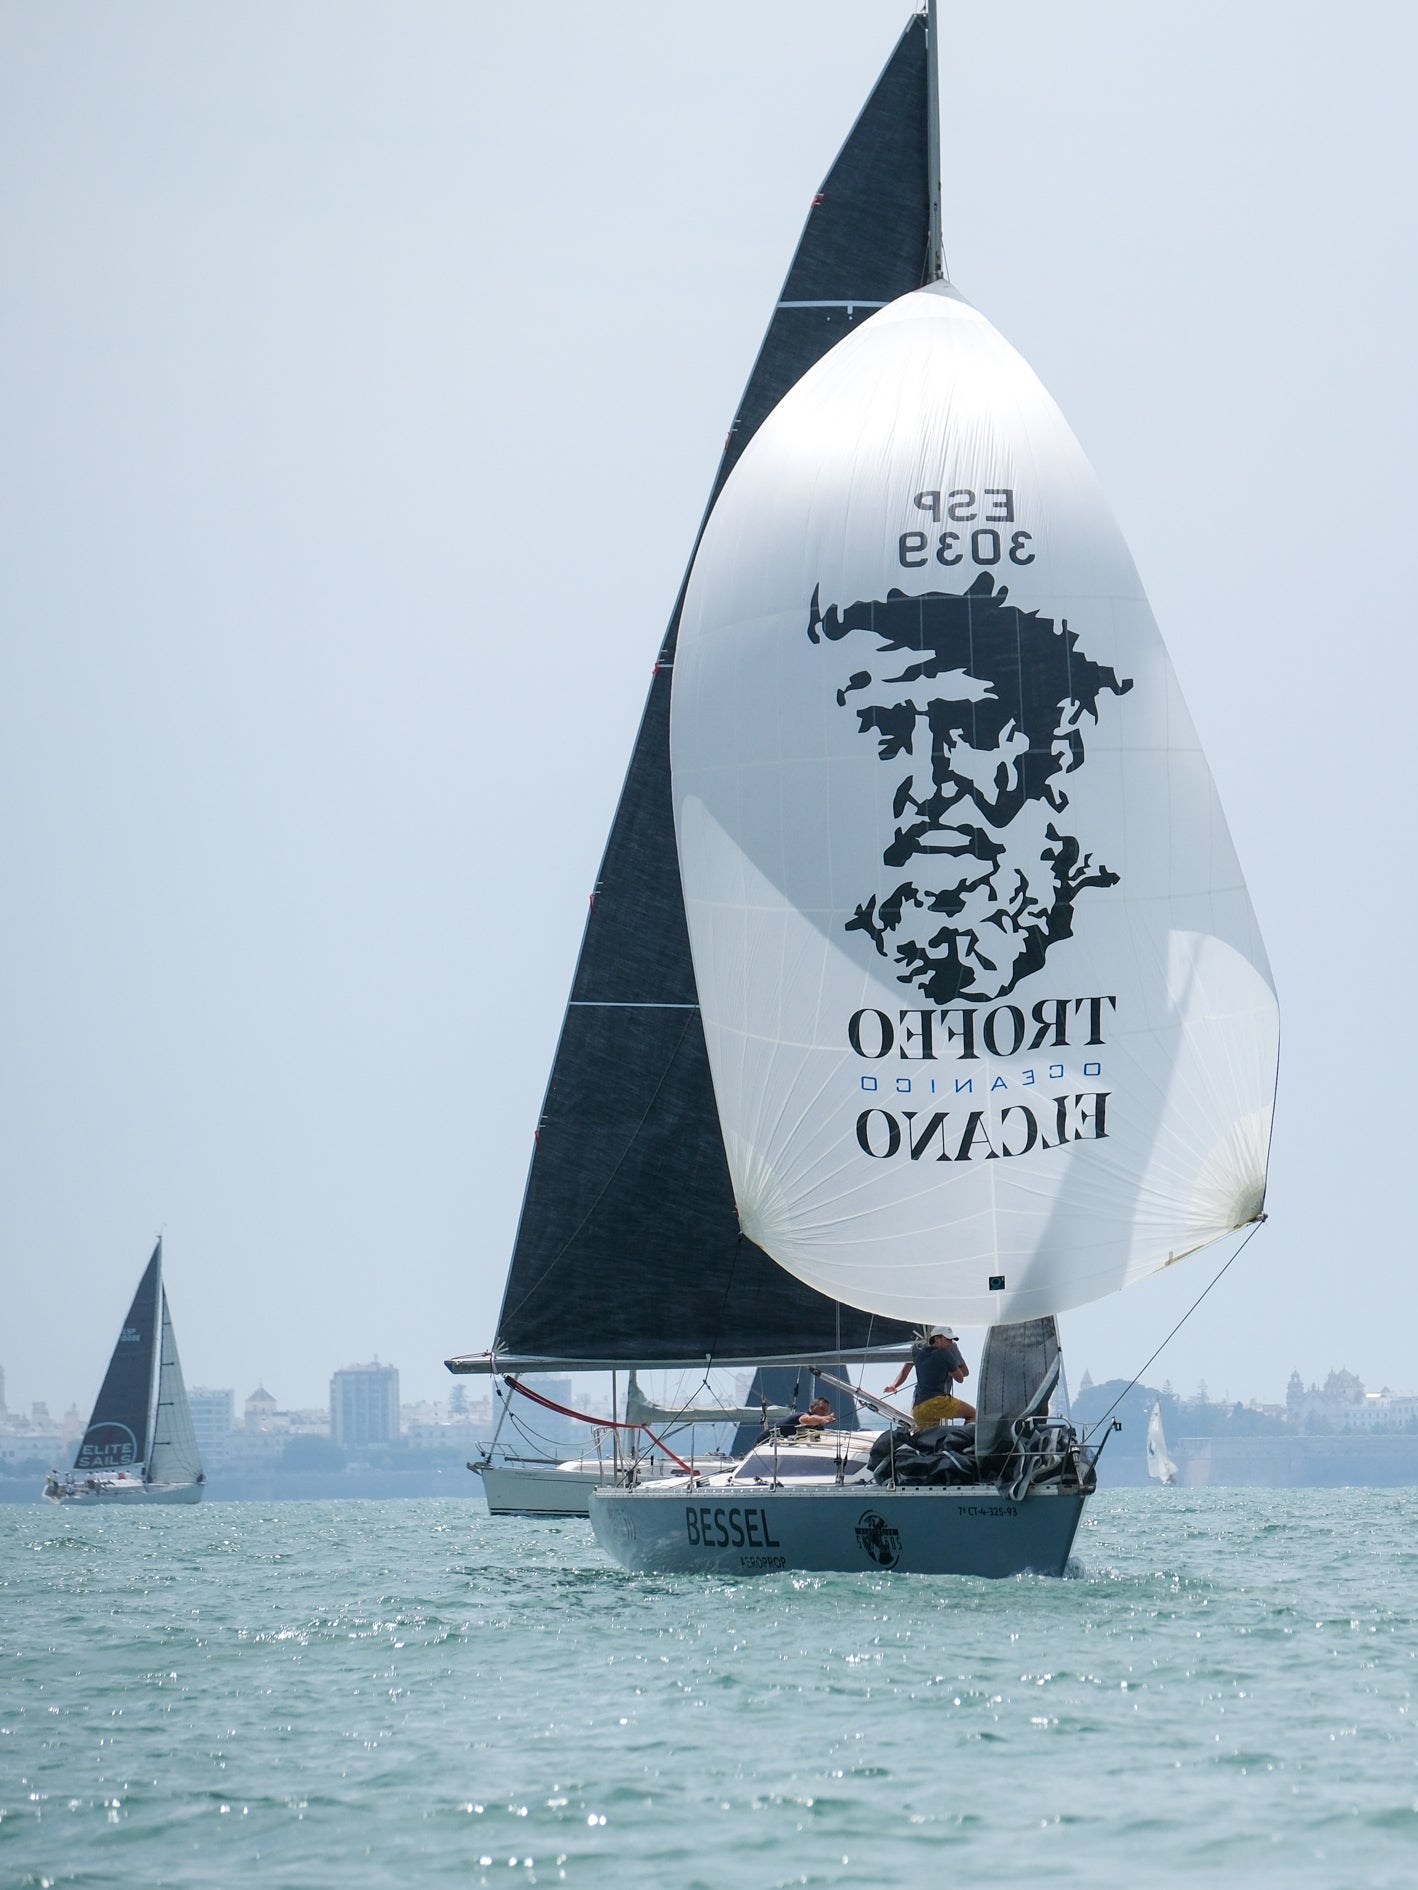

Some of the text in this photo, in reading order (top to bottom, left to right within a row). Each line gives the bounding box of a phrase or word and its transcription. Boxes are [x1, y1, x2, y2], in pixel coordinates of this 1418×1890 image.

[82, 1442, 132, 1456] ELITE
[78, 1454, 132, 1467] SAILS
[686, 1506, 781, 1548] BESSEL
